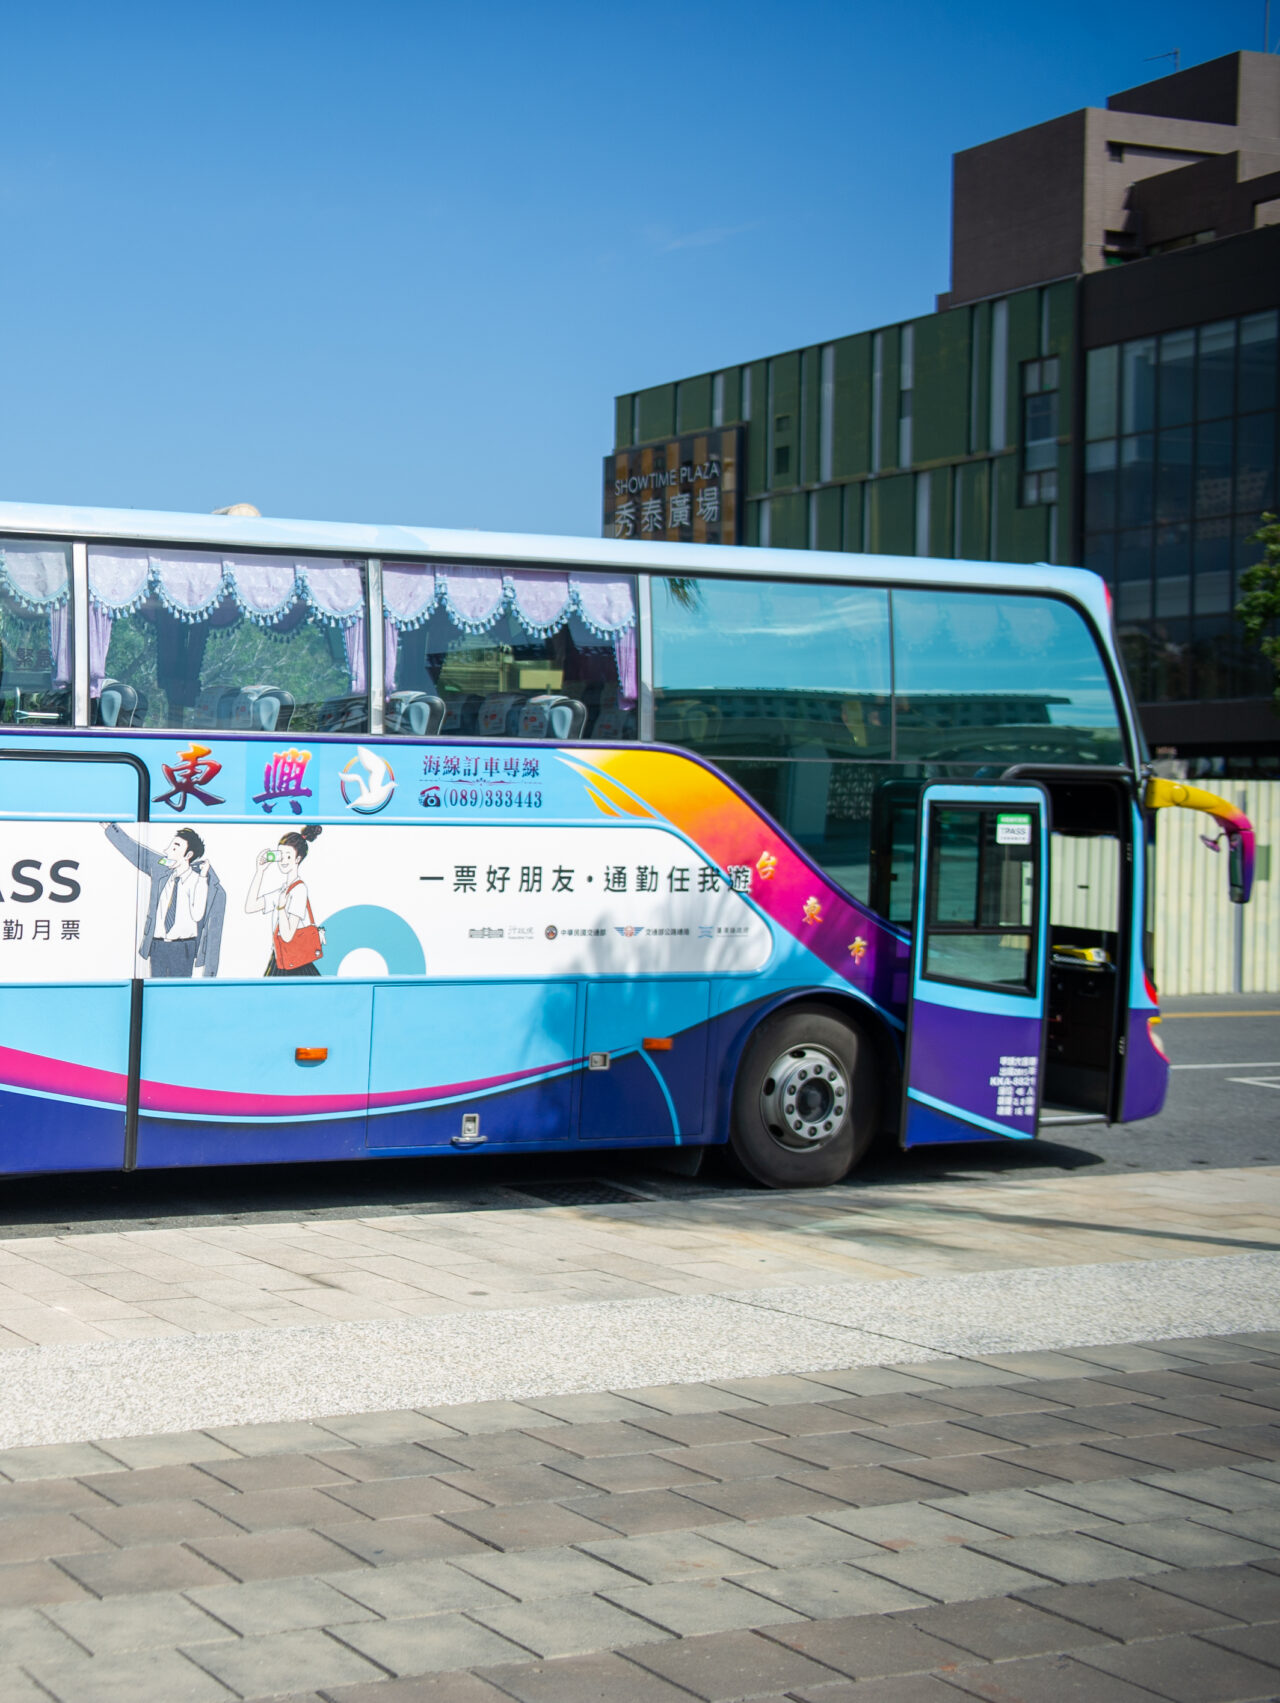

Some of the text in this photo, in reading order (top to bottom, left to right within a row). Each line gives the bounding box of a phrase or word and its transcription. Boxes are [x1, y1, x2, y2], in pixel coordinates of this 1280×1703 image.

[614, 462, 720, 496] SHOWTIME PLAZA
[615, 487, 720, 537] 秀泰廣場
[423, 755, 540, 778] 海線訂車專線
[443, 788, 542, 809] (089)333443
